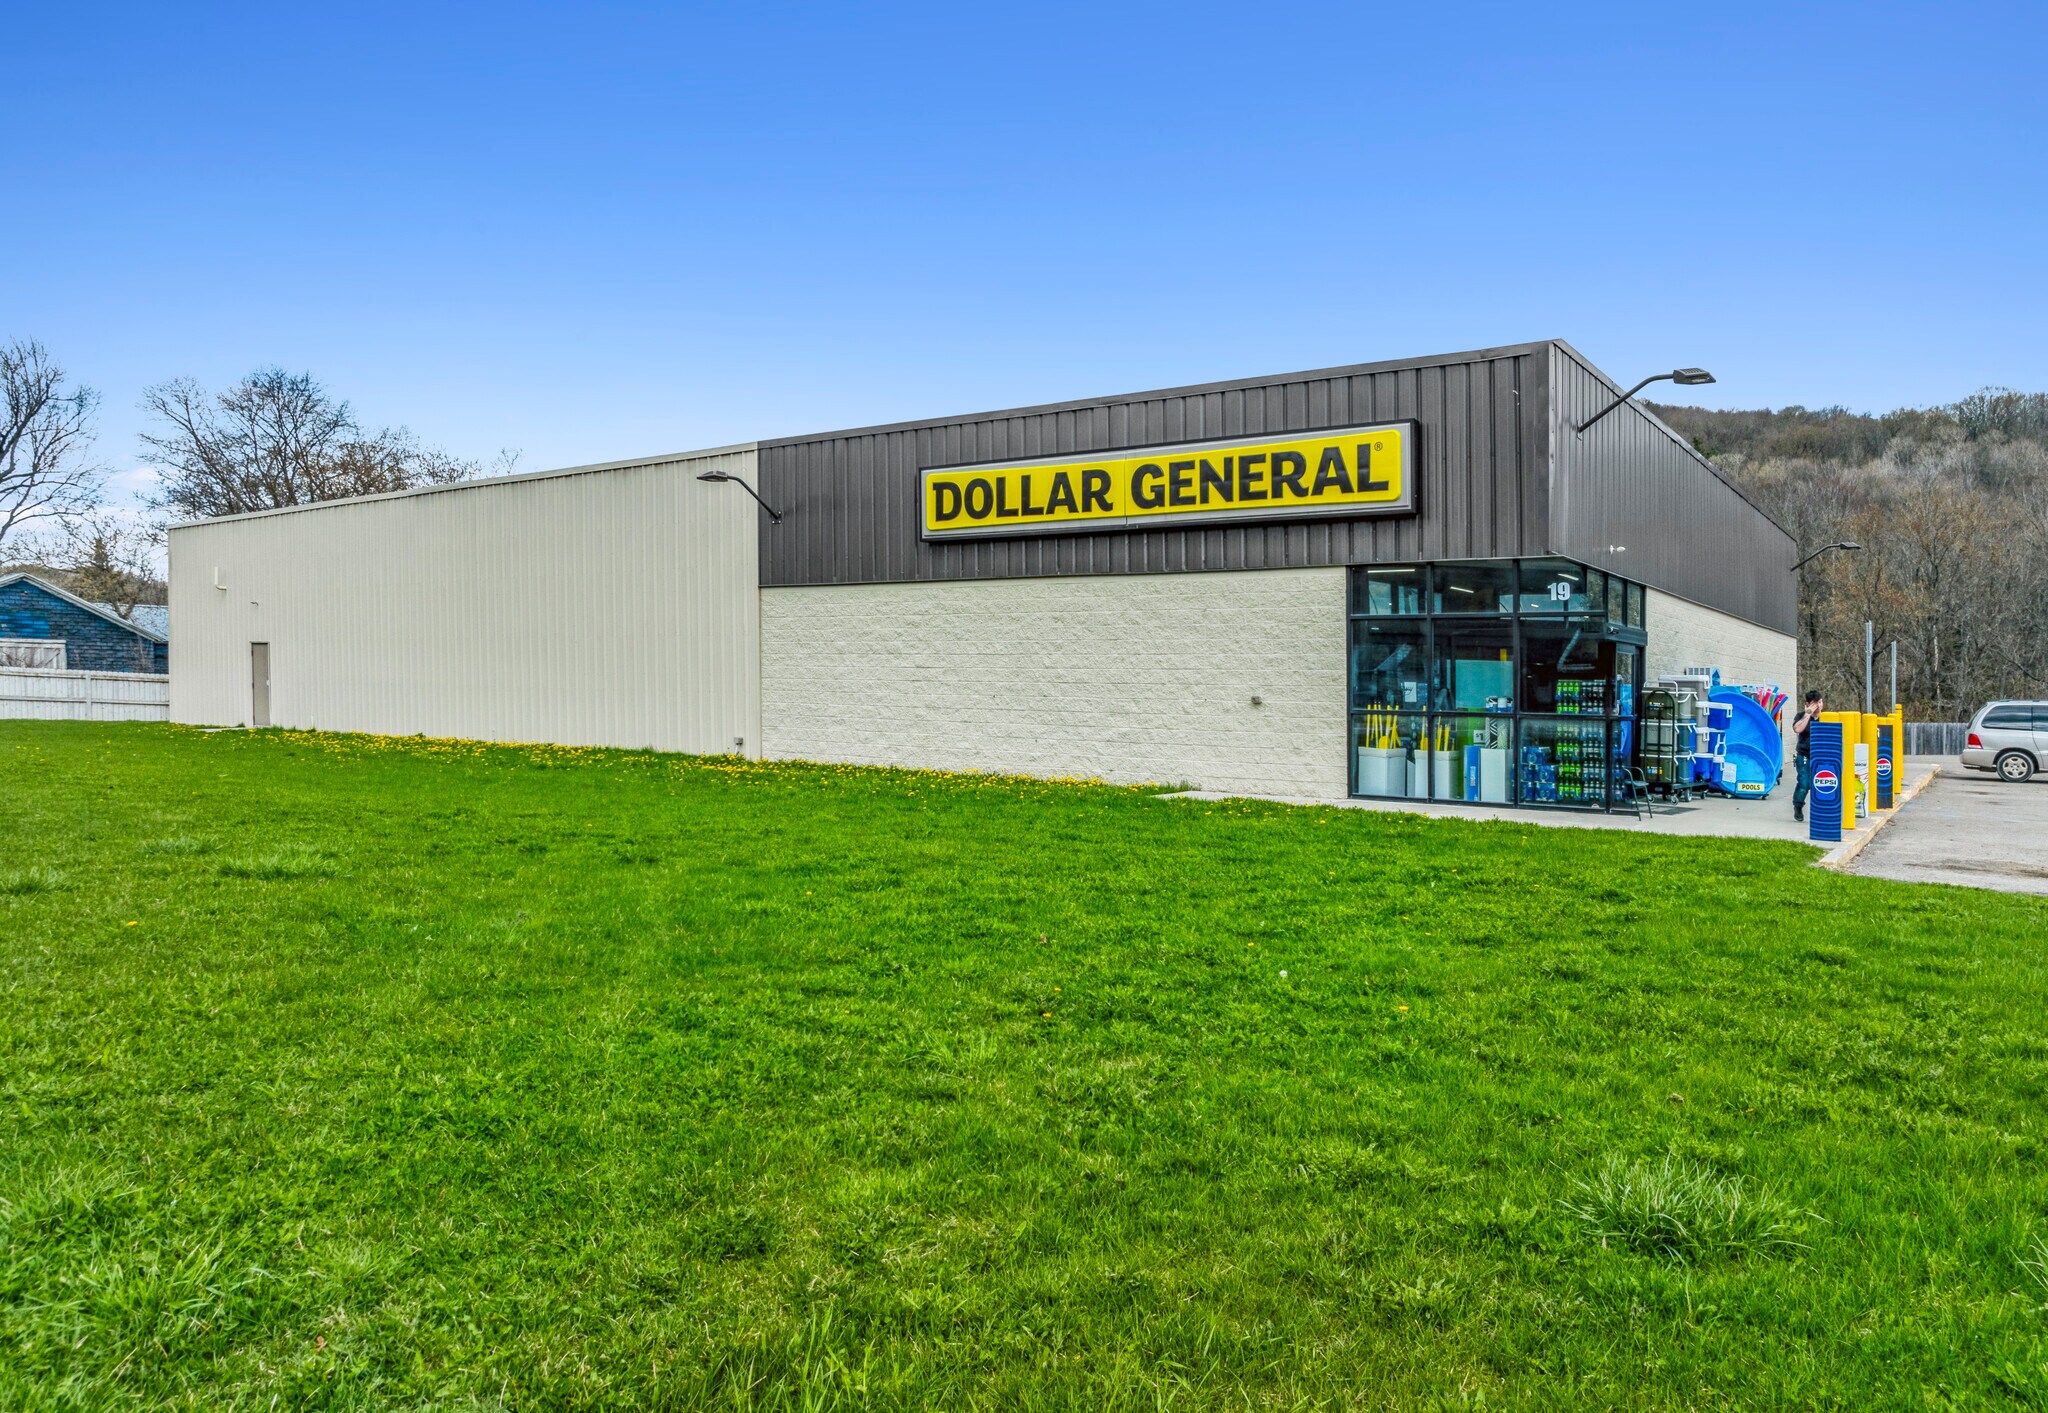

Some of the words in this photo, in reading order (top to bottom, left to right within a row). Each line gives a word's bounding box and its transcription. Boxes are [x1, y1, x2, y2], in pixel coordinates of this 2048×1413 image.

[932, 469, 1113, 522] DOLLAR
[1130, 442, 1390, 509] GENERAL
[1547, 582, 1571, 601] 19
